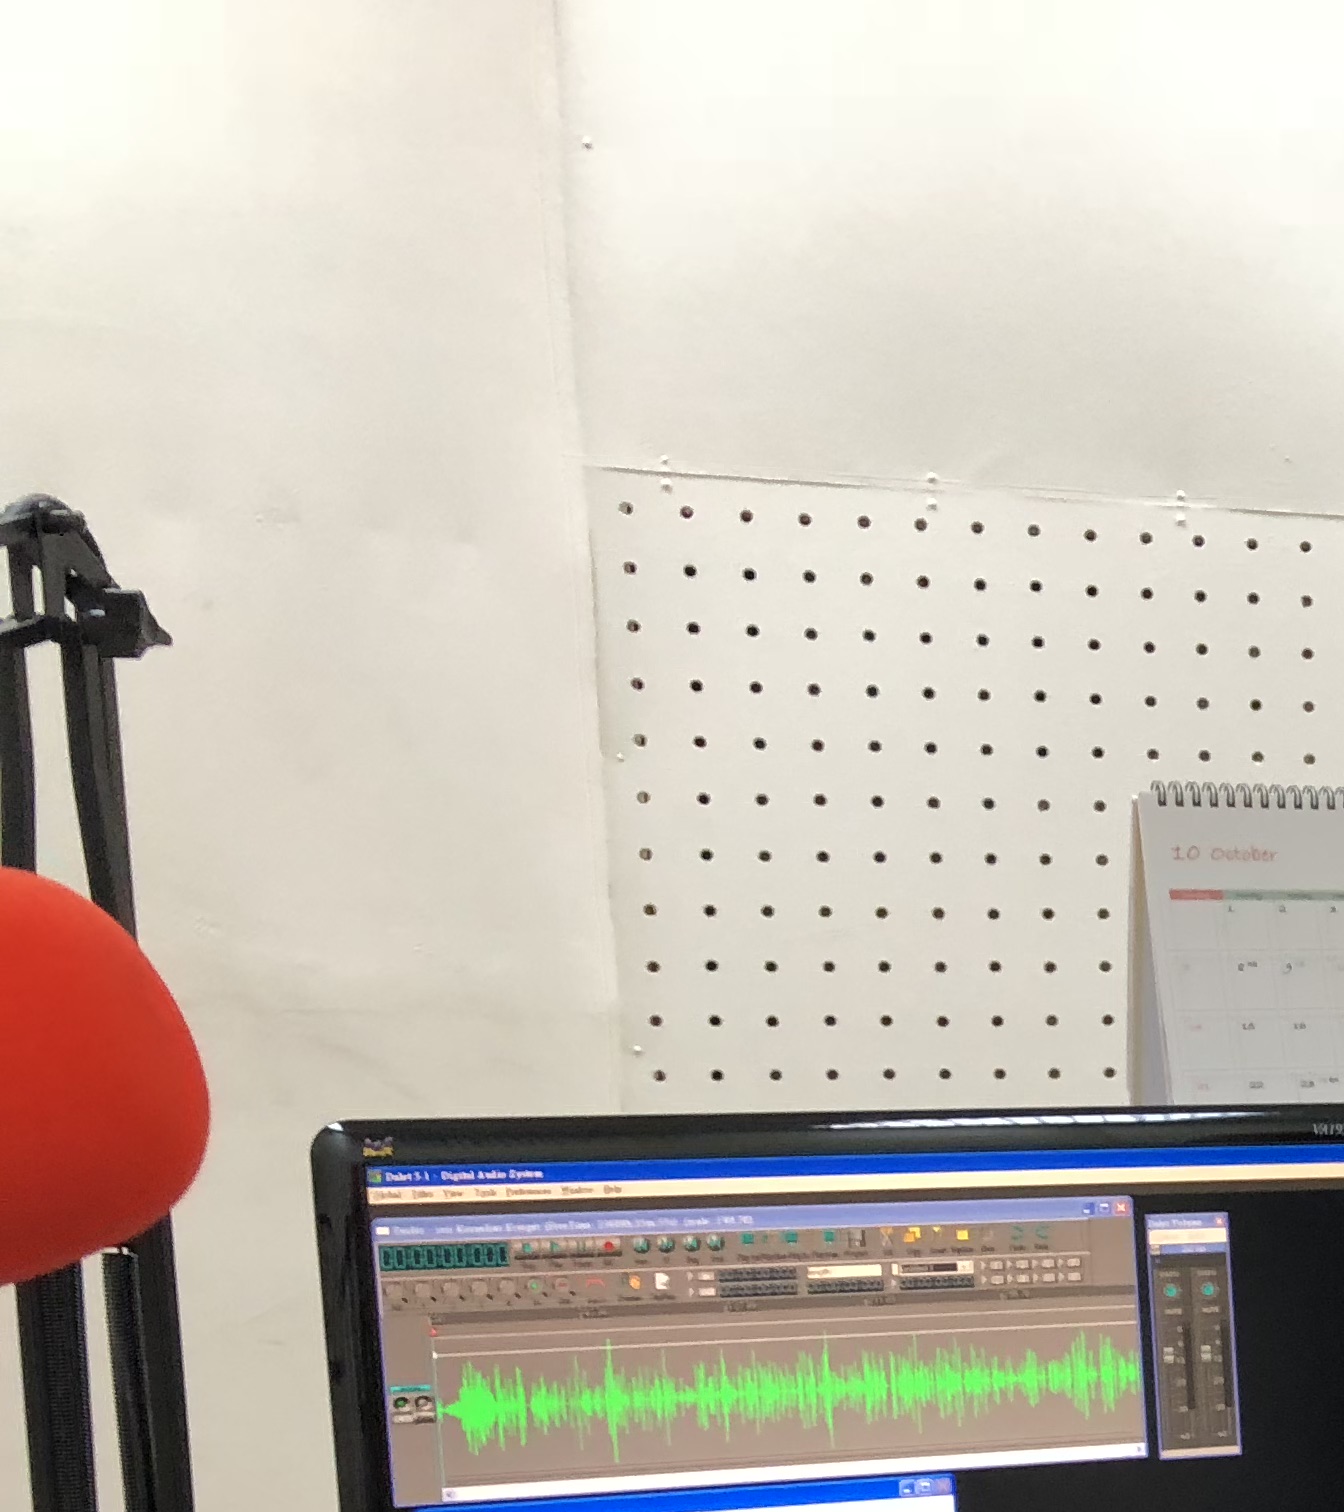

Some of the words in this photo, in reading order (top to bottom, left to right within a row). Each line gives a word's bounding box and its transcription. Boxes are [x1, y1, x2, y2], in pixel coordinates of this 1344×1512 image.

[1171, 845, 1200, 861] 10
[1210, 845, 1278, 862] October
[441, 1170, 474, 1182] Digital
[478, 1169, 506, 1180] Audio
[509, 1168, 544, 1180] System
